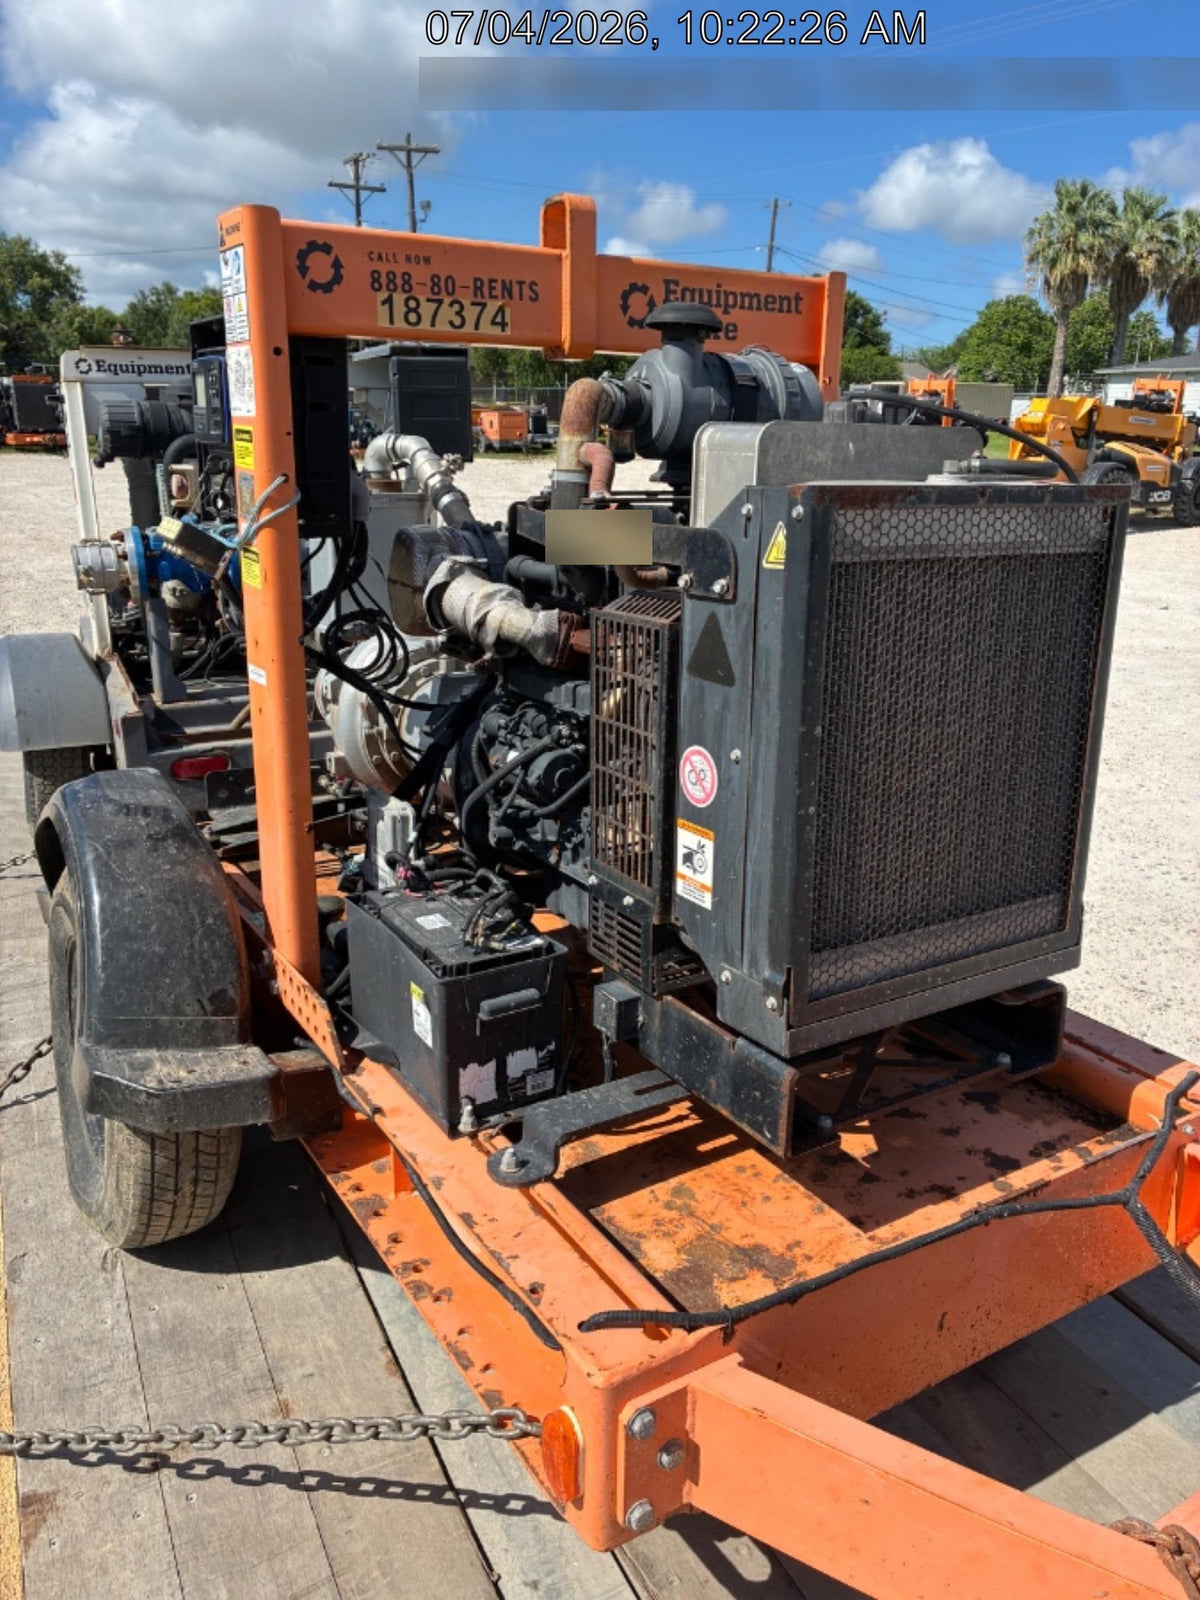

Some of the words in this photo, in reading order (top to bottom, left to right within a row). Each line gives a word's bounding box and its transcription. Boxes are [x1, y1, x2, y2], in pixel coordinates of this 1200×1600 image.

[367, 250, 400, 264] CALL
[404, 253, 431, 266] NOW
[369, 269, 540, 302] 888-80-RENTS
[380, 293, 509, 333] 187374
[1148, 490, 1171, 503] JCB
